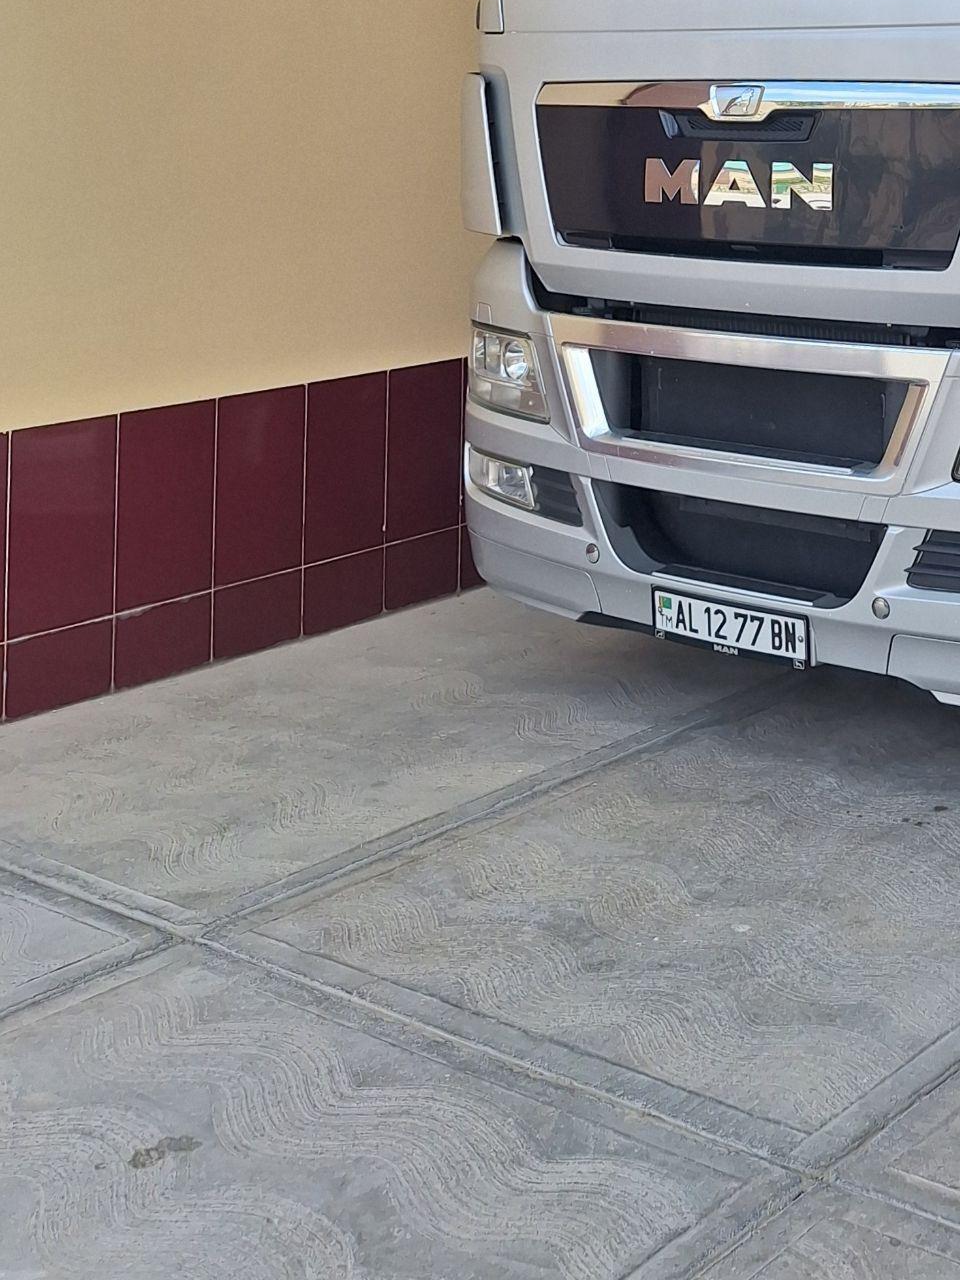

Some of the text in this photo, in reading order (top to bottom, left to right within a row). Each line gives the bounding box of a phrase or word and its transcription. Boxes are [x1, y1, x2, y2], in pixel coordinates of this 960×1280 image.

[644, 157, 834, 211] MAN
[675, 600, 698, 633] AL
[770, 618, 797, 654] BN
[713, 643, 739, 656] MAN
